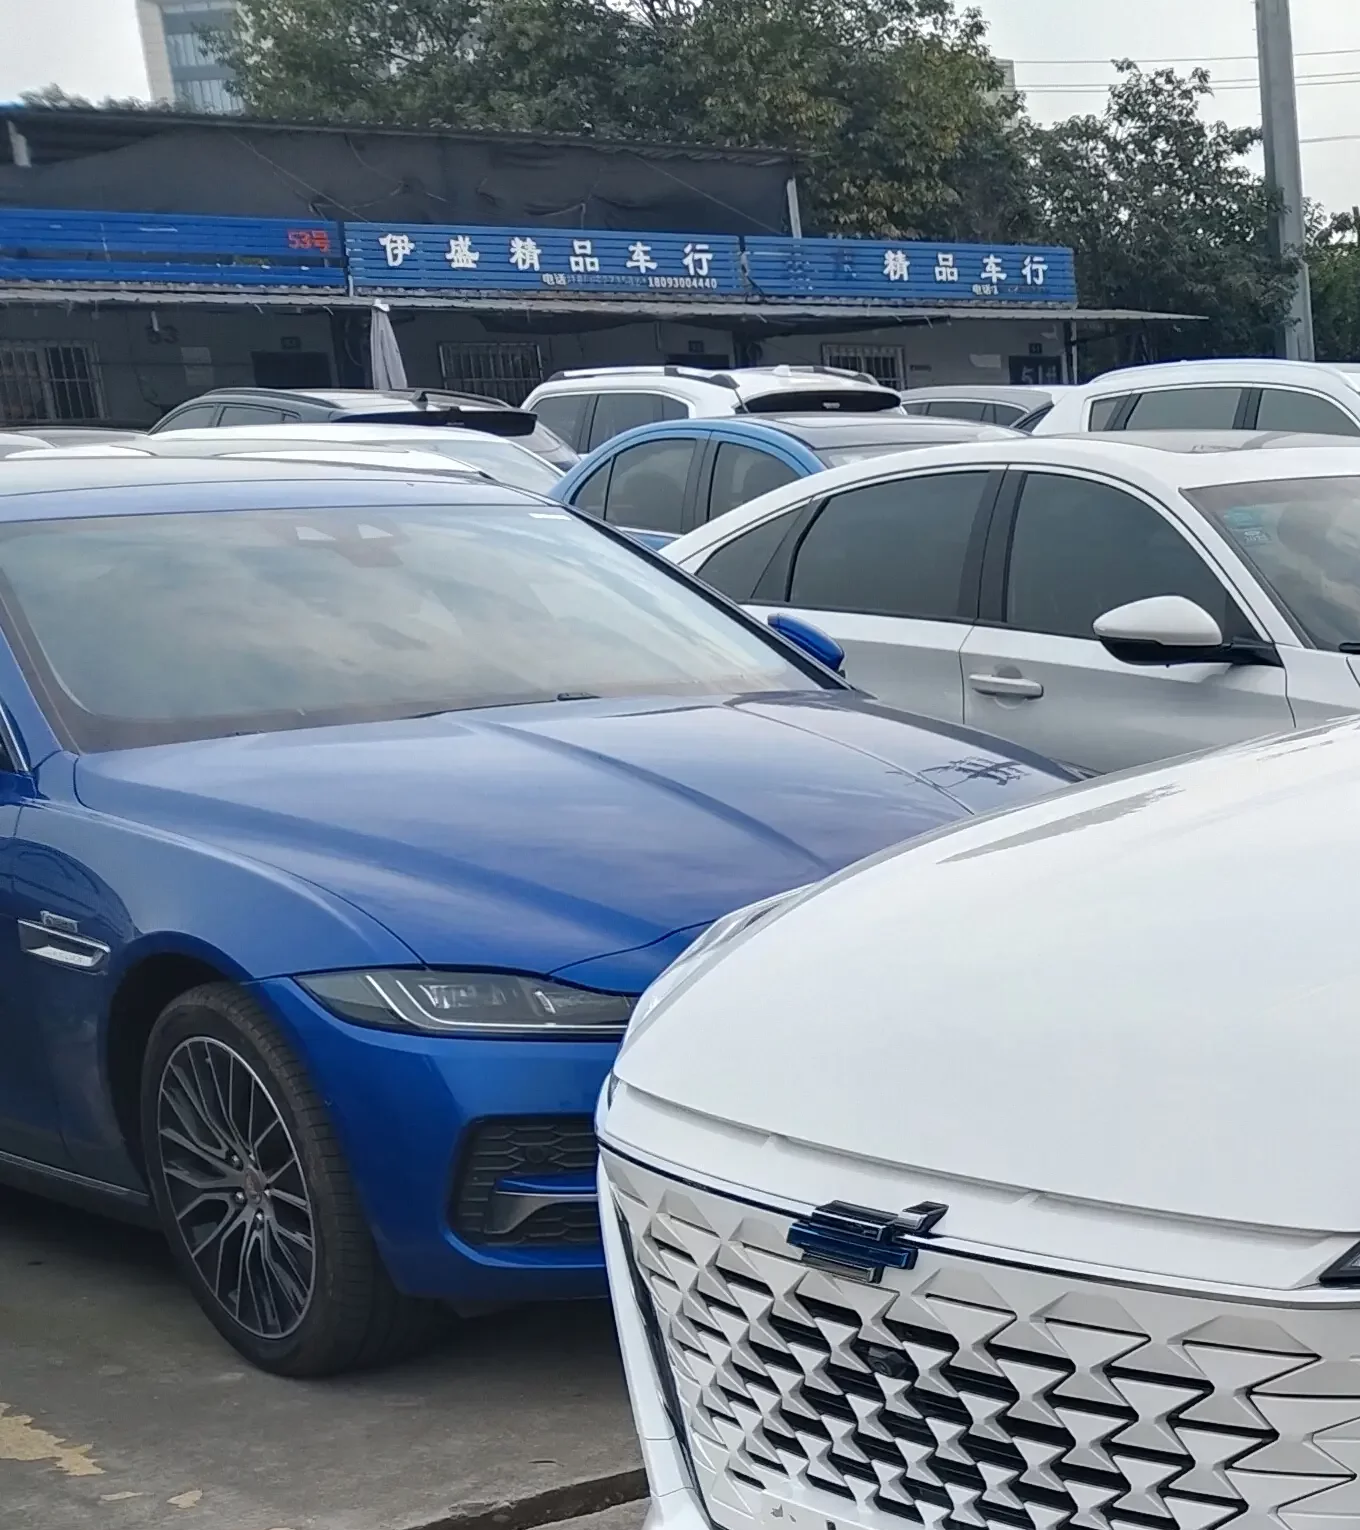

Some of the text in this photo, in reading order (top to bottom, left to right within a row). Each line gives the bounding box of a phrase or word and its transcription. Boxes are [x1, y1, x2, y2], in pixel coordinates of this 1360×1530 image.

[287, 229, 330, 253] 53号
[378, 233, 713, 276] 伊盛精品车行
[543, 273, 567, 286] 电话
[648, 276, 717, 289] 18093004440
[883, 249, 1048, 286] 精品车行
